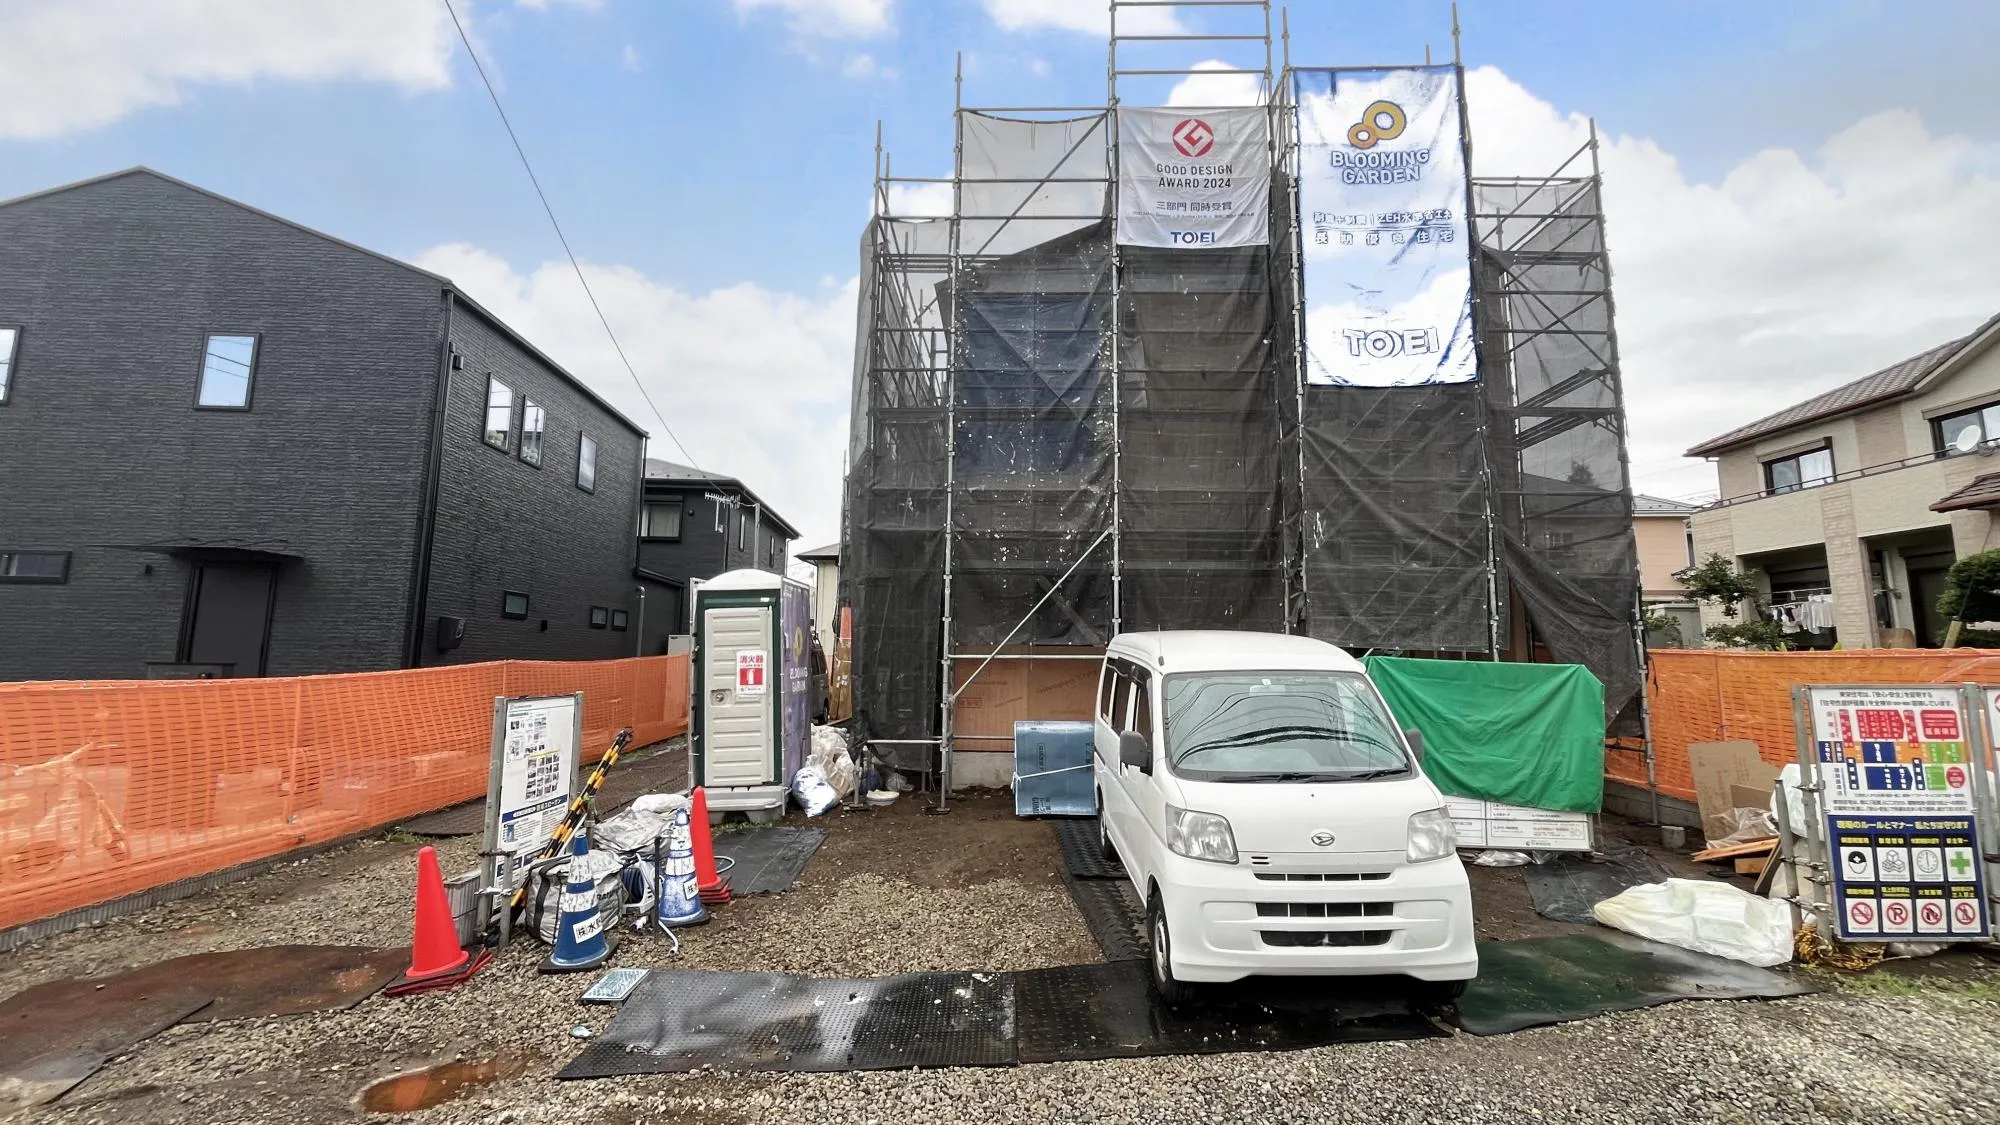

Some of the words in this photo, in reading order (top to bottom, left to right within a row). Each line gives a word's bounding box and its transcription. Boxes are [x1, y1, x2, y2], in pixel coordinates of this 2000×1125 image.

[1332, 149, 1429, 168] BLOOMING
[1156, 163, 1187, 175] GOOD
[1191, 164, 1233, 176] DESIGN
[1342, 165, 1420, 184] GARDEN
[1158, 177, 1200, 188] AWARD
[1203, 177, 1231, 188] 2024
[1156, 201, 1187, 212] 三部門
[1190, 201, 1232, 212] 同時受賞
